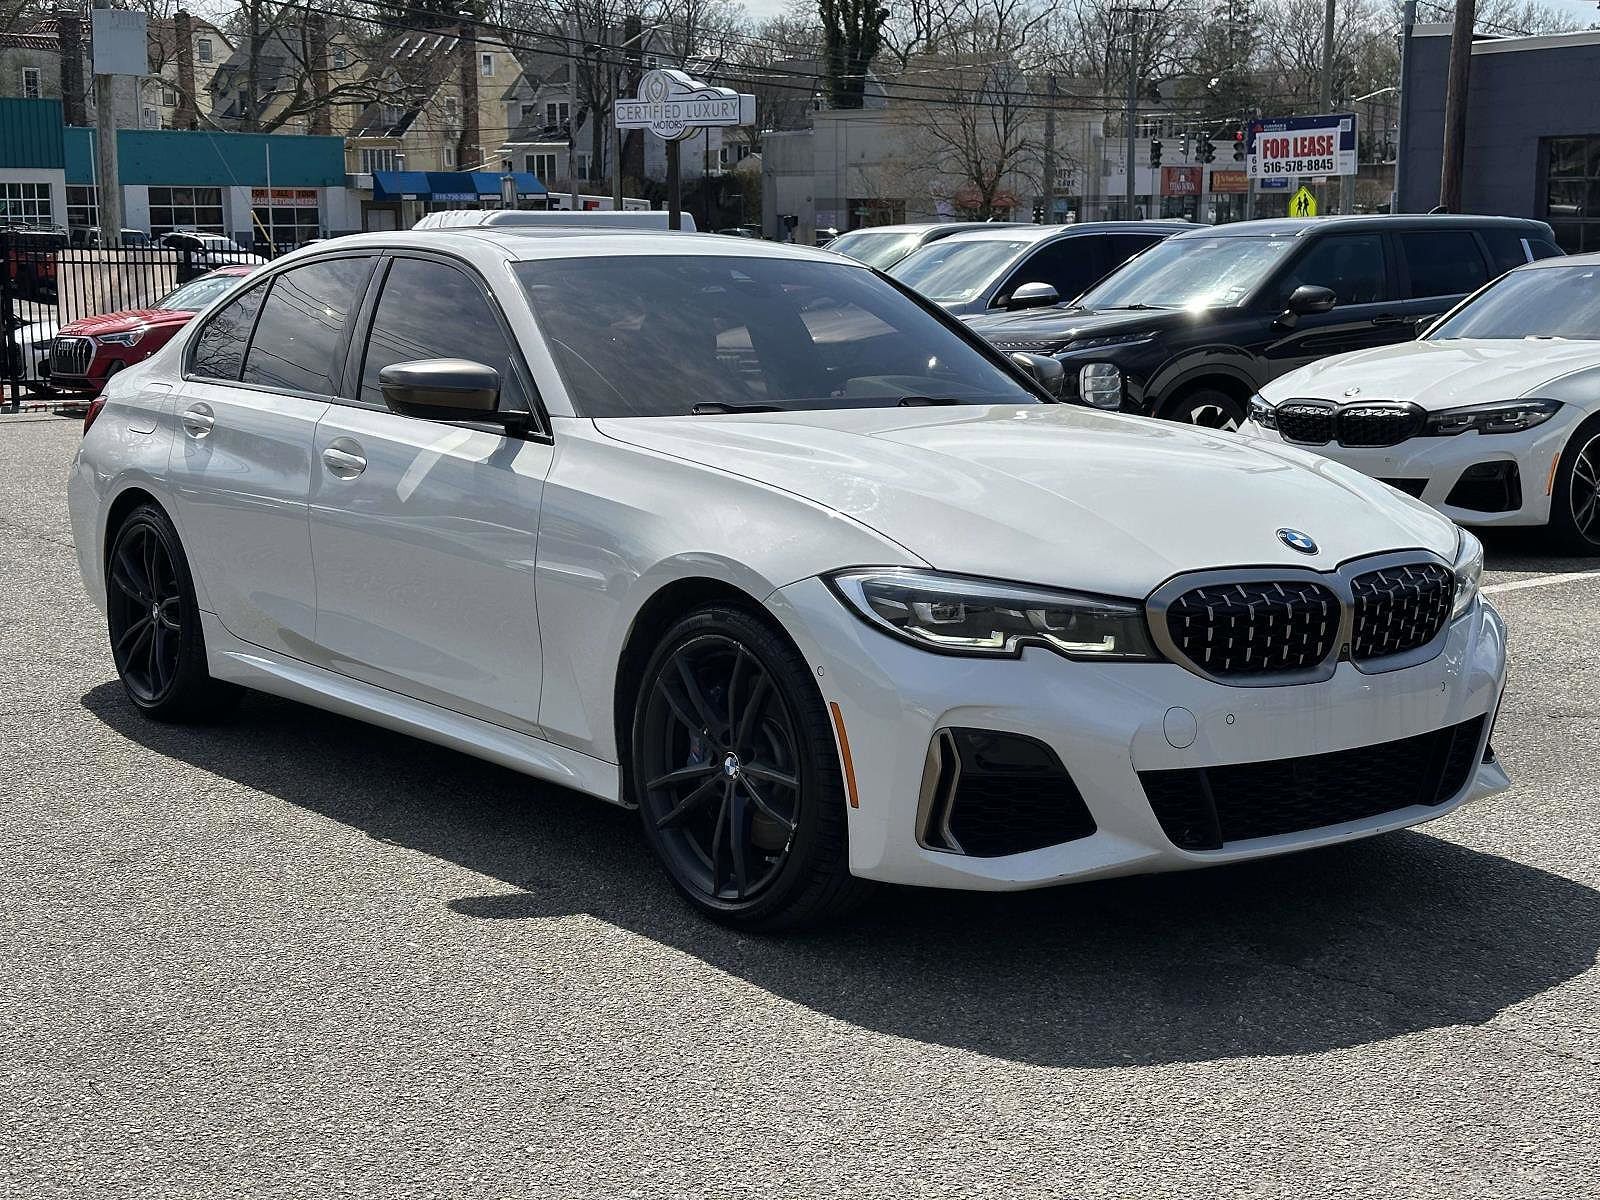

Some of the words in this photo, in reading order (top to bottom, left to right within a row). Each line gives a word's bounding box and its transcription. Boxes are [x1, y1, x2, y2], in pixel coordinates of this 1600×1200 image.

[616, 105, 681, 120] CERTIFIED
[686, 102, 738, 118] LUXURY
[653, 120, 683, 130] MOTORS
[1263, 138, 1290, 159] FOR
[1293, 135, 1334, 157] LEASE
[1263, 159, 1334, 173] 516-578-8845
